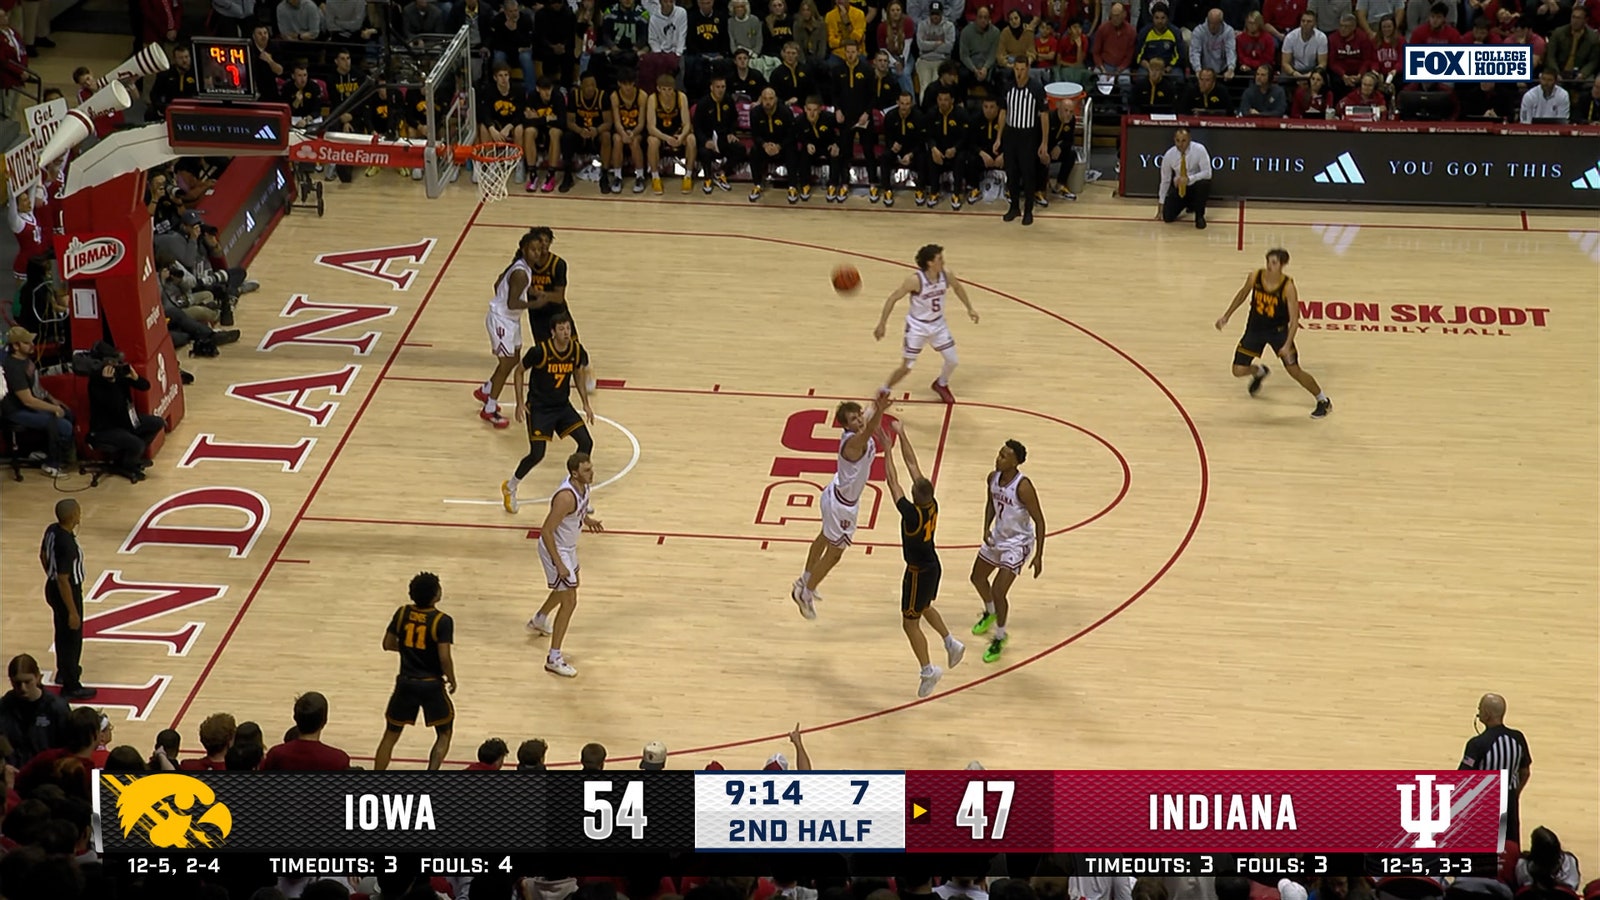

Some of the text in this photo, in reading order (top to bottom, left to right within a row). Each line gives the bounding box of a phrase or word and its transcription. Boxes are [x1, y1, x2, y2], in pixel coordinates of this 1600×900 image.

[614, 22, 637, 44] 74
[696, 24, 719, 34] IOWA
[210, 47, 244, 64] 9:14
[226, 64, 240, 86] 7
[34, 104, 54, 126] Get
[176, 124, 251, 134] YOU GOT THIS
[1211, 156, 1240, 171] OT
[1252, 157, 1305, 172] THIS
[1389, 161, 1562, 178] YOU GOT THIS
[66, 243, 117, 274] LIBMAN
[932, 298, 940, 312] 5
[1298, 300, 1550, 326] MON SKJODT
[1442, 327, 1511, 336] HALL
[548, 363, 574, 374] IOWA
[554, 374, 566, 388] 7
[42, 238, 438, 720] INDIANA
[404, 622, 427, 650] 11
